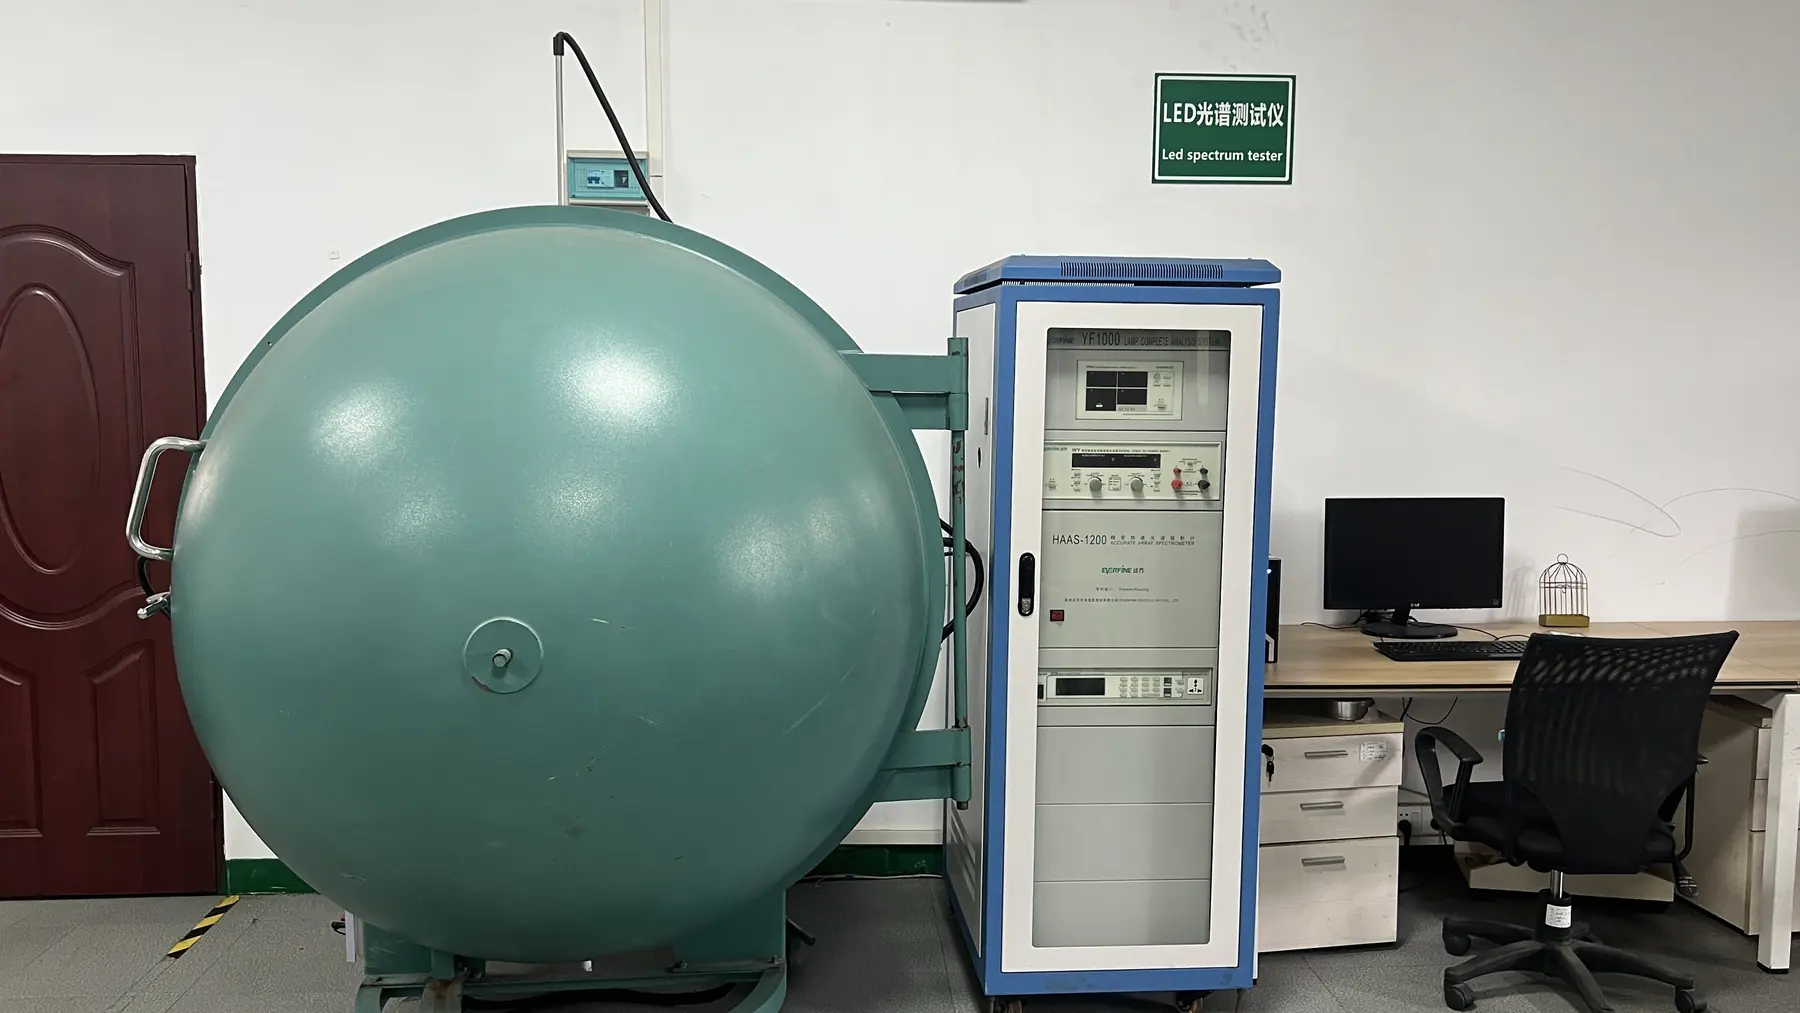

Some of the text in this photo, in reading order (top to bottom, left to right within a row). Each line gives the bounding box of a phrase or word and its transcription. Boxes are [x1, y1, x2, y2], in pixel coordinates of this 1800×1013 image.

[1163, 101, 1284, 127] LED光谱测试仪
[1162, 148, 1283, 163] Led spectrum tester
[1081, 331, 1121, 346] YF1000
[1140, 336, 1169, 346] COMPLETE
[1052, 534, 1107, 545] HAAS-1200
